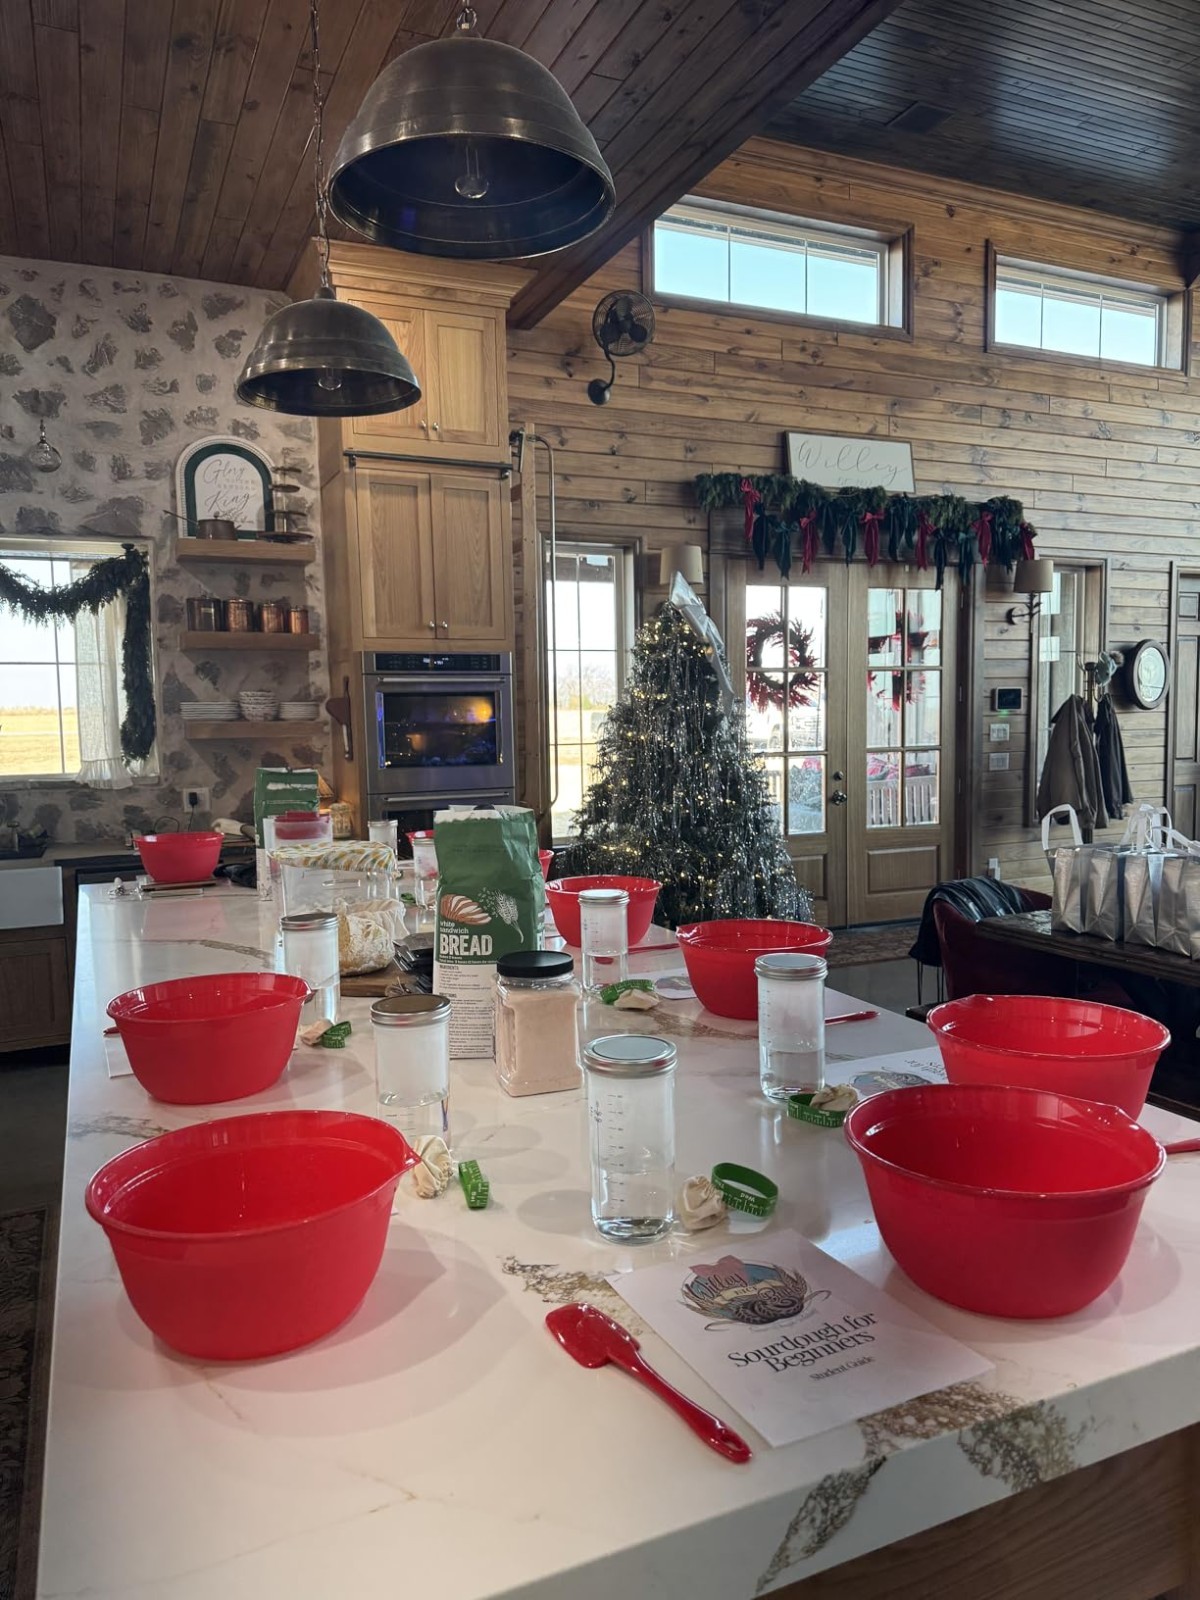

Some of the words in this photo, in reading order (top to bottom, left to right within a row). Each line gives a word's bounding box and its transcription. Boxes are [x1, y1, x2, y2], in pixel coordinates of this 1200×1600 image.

[203, 459, 246, 484] Glory
[797, 440, 909, 486] Willey
[204, 490, 257, 513] King
[439, 934, 493, 956] BREAD
[685, 1272, 748, 1299] Willey
[728, 1322, 851, 1367] Sourdough
[842, 1312, 879, 1334] for
[764, 1331, 876, 1372] Beginners
[809, 1365, 847, 1382] Student
[845, 1355, 876, 1370] Guide
